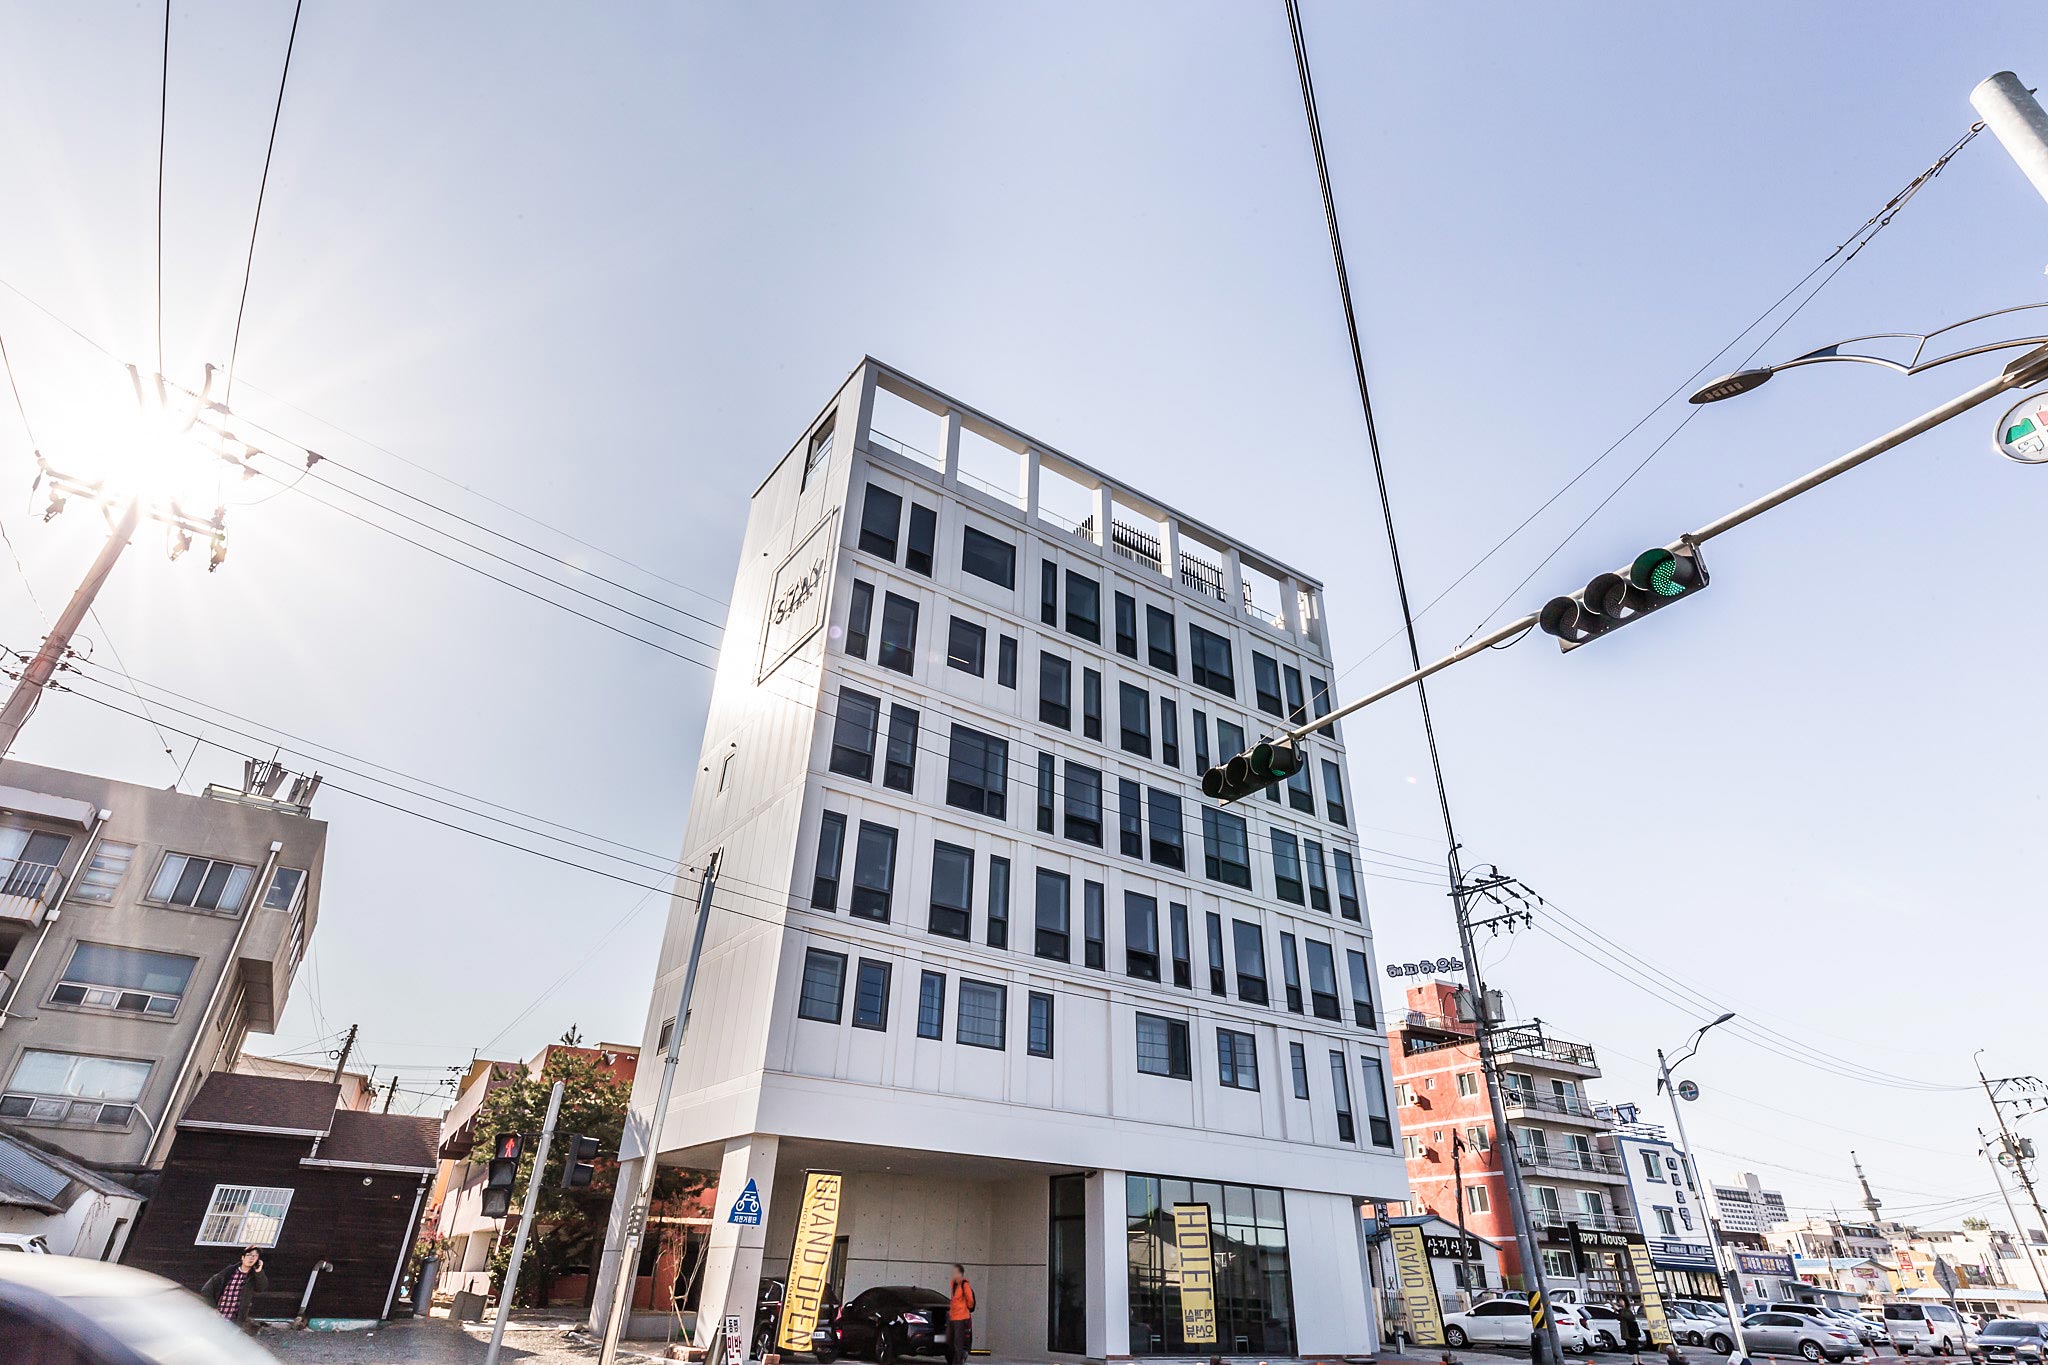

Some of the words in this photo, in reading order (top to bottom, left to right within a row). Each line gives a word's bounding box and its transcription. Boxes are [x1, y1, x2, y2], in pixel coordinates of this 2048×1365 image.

[1386, 956, 1465, 978] 해피하우스
[799, 1207, 809, 1234] HOTEL
[804, 1177, 839, 1266] GRAND
[1600, 1233, 1628, 1246] House
[785, 1278, 795, 1310] HOUSE
[784, 1275, 823, 1348] OPEN
[727, 1335, 742, 1359] 민박
